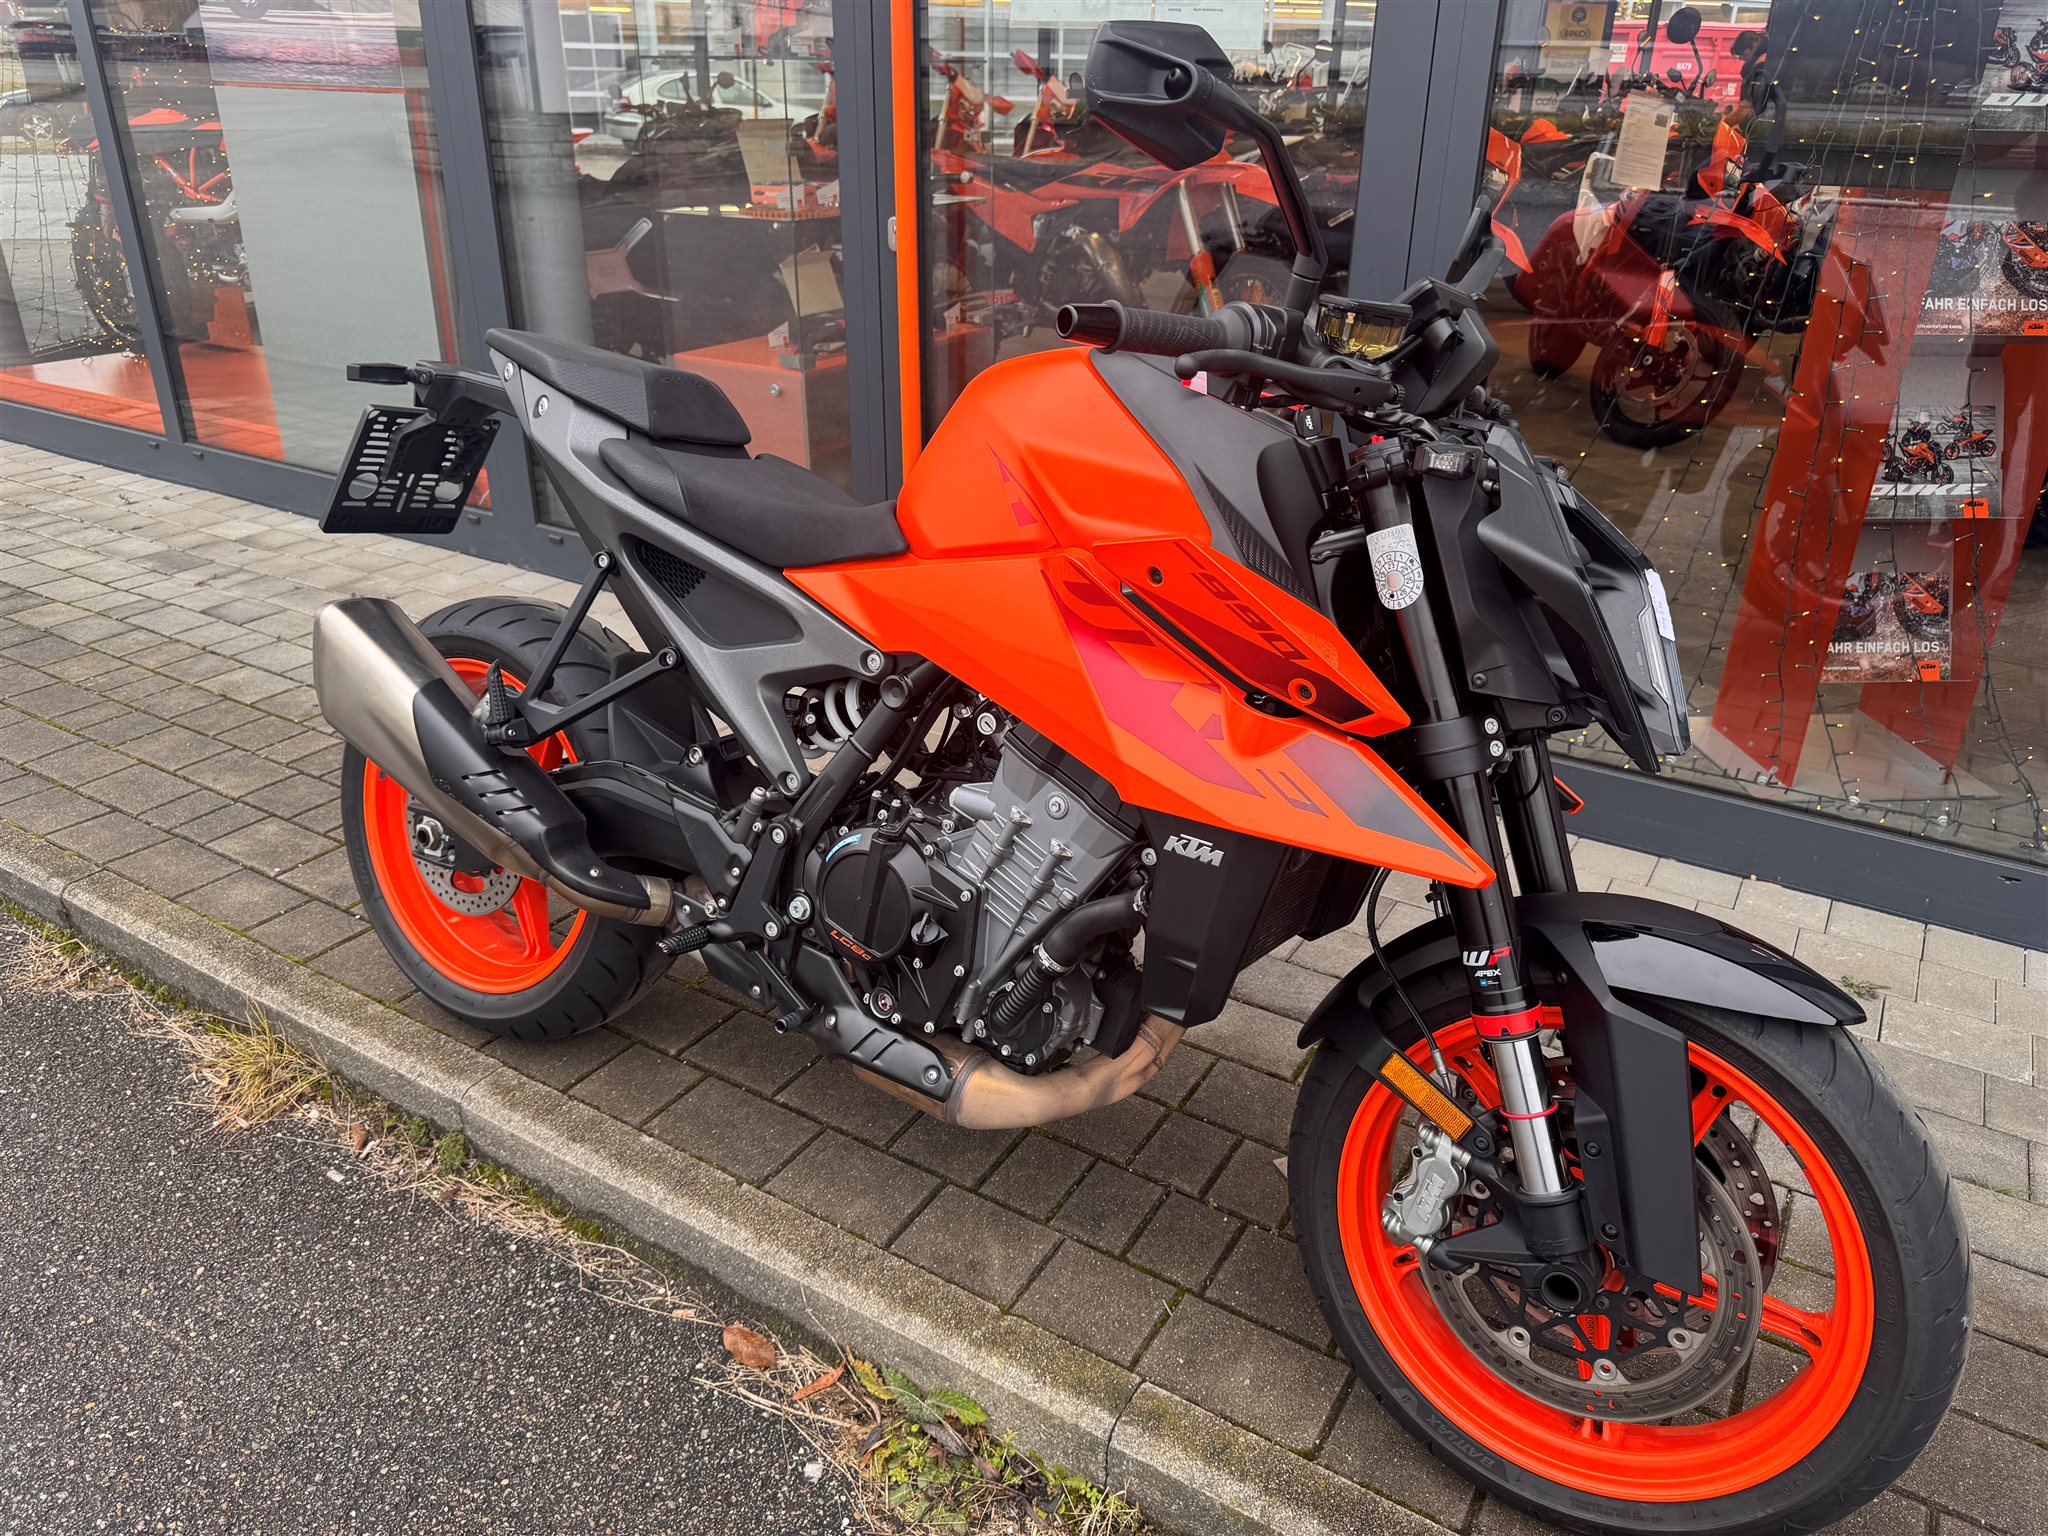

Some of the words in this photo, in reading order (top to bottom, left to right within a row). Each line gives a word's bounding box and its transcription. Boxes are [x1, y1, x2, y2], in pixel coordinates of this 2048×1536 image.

[1922, 297, 1954, 310] AHR
[1957, 298, 2017, 311] EINFACH
[2020, 298, 2048, 312] LOS
[1870, 483, 1989, 496] DUKE
[1190, 571, 1310, 661] 990
[1856, 641, 1911, 653] EINFACH
[1913, 641, 1941, 653] LOS
[1162, 833, 1225, 867] KTM
[1462, 946, 1512, 967] WP
[1474, 968, 1502, 978] APEX
[1416, 1172, 1446, 1224] KTM
[1424, 1413, 1496, 1470] BATTLAX
